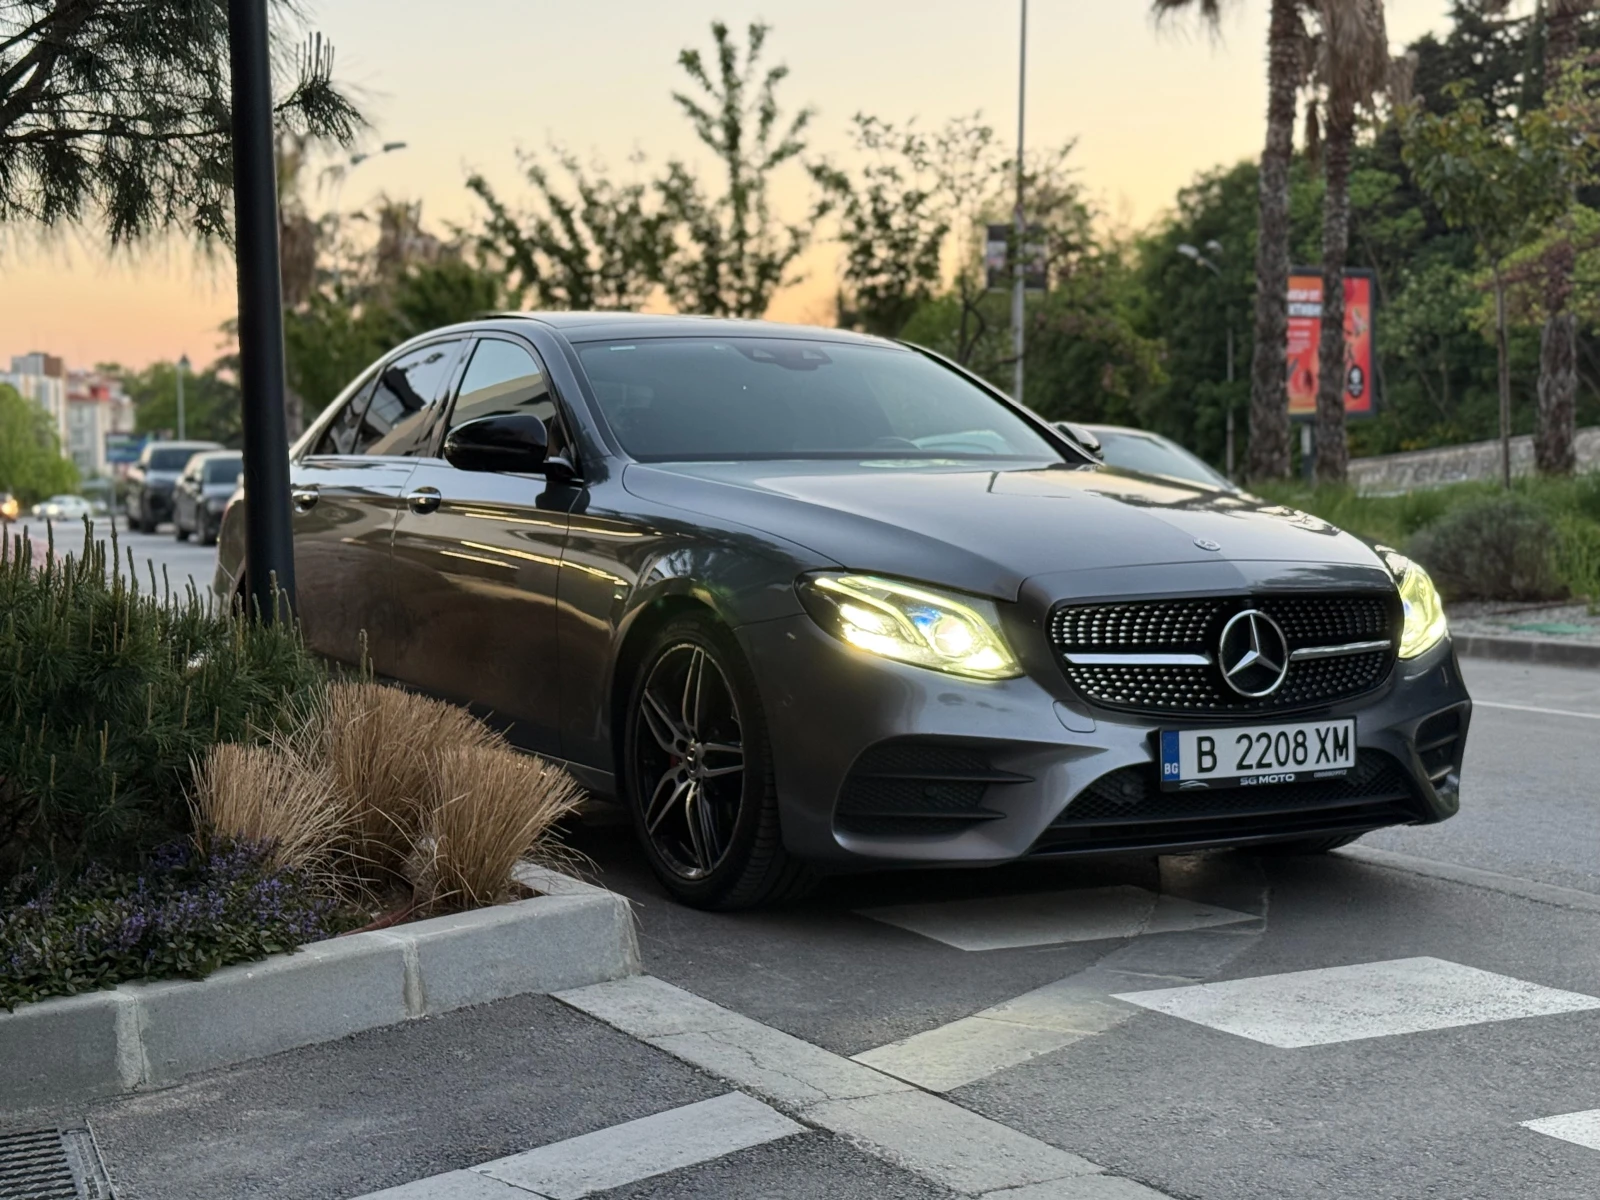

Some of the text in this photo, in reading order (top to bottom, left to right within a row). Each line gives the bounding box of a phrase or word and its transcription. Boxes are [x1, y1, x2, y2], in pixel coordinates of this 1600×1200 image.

[1197, 725, 1349, 773] B 2208 XM
[1164, 762, 1179, 775] BG
[1240, 773, 1295, 786] SG MOTO
